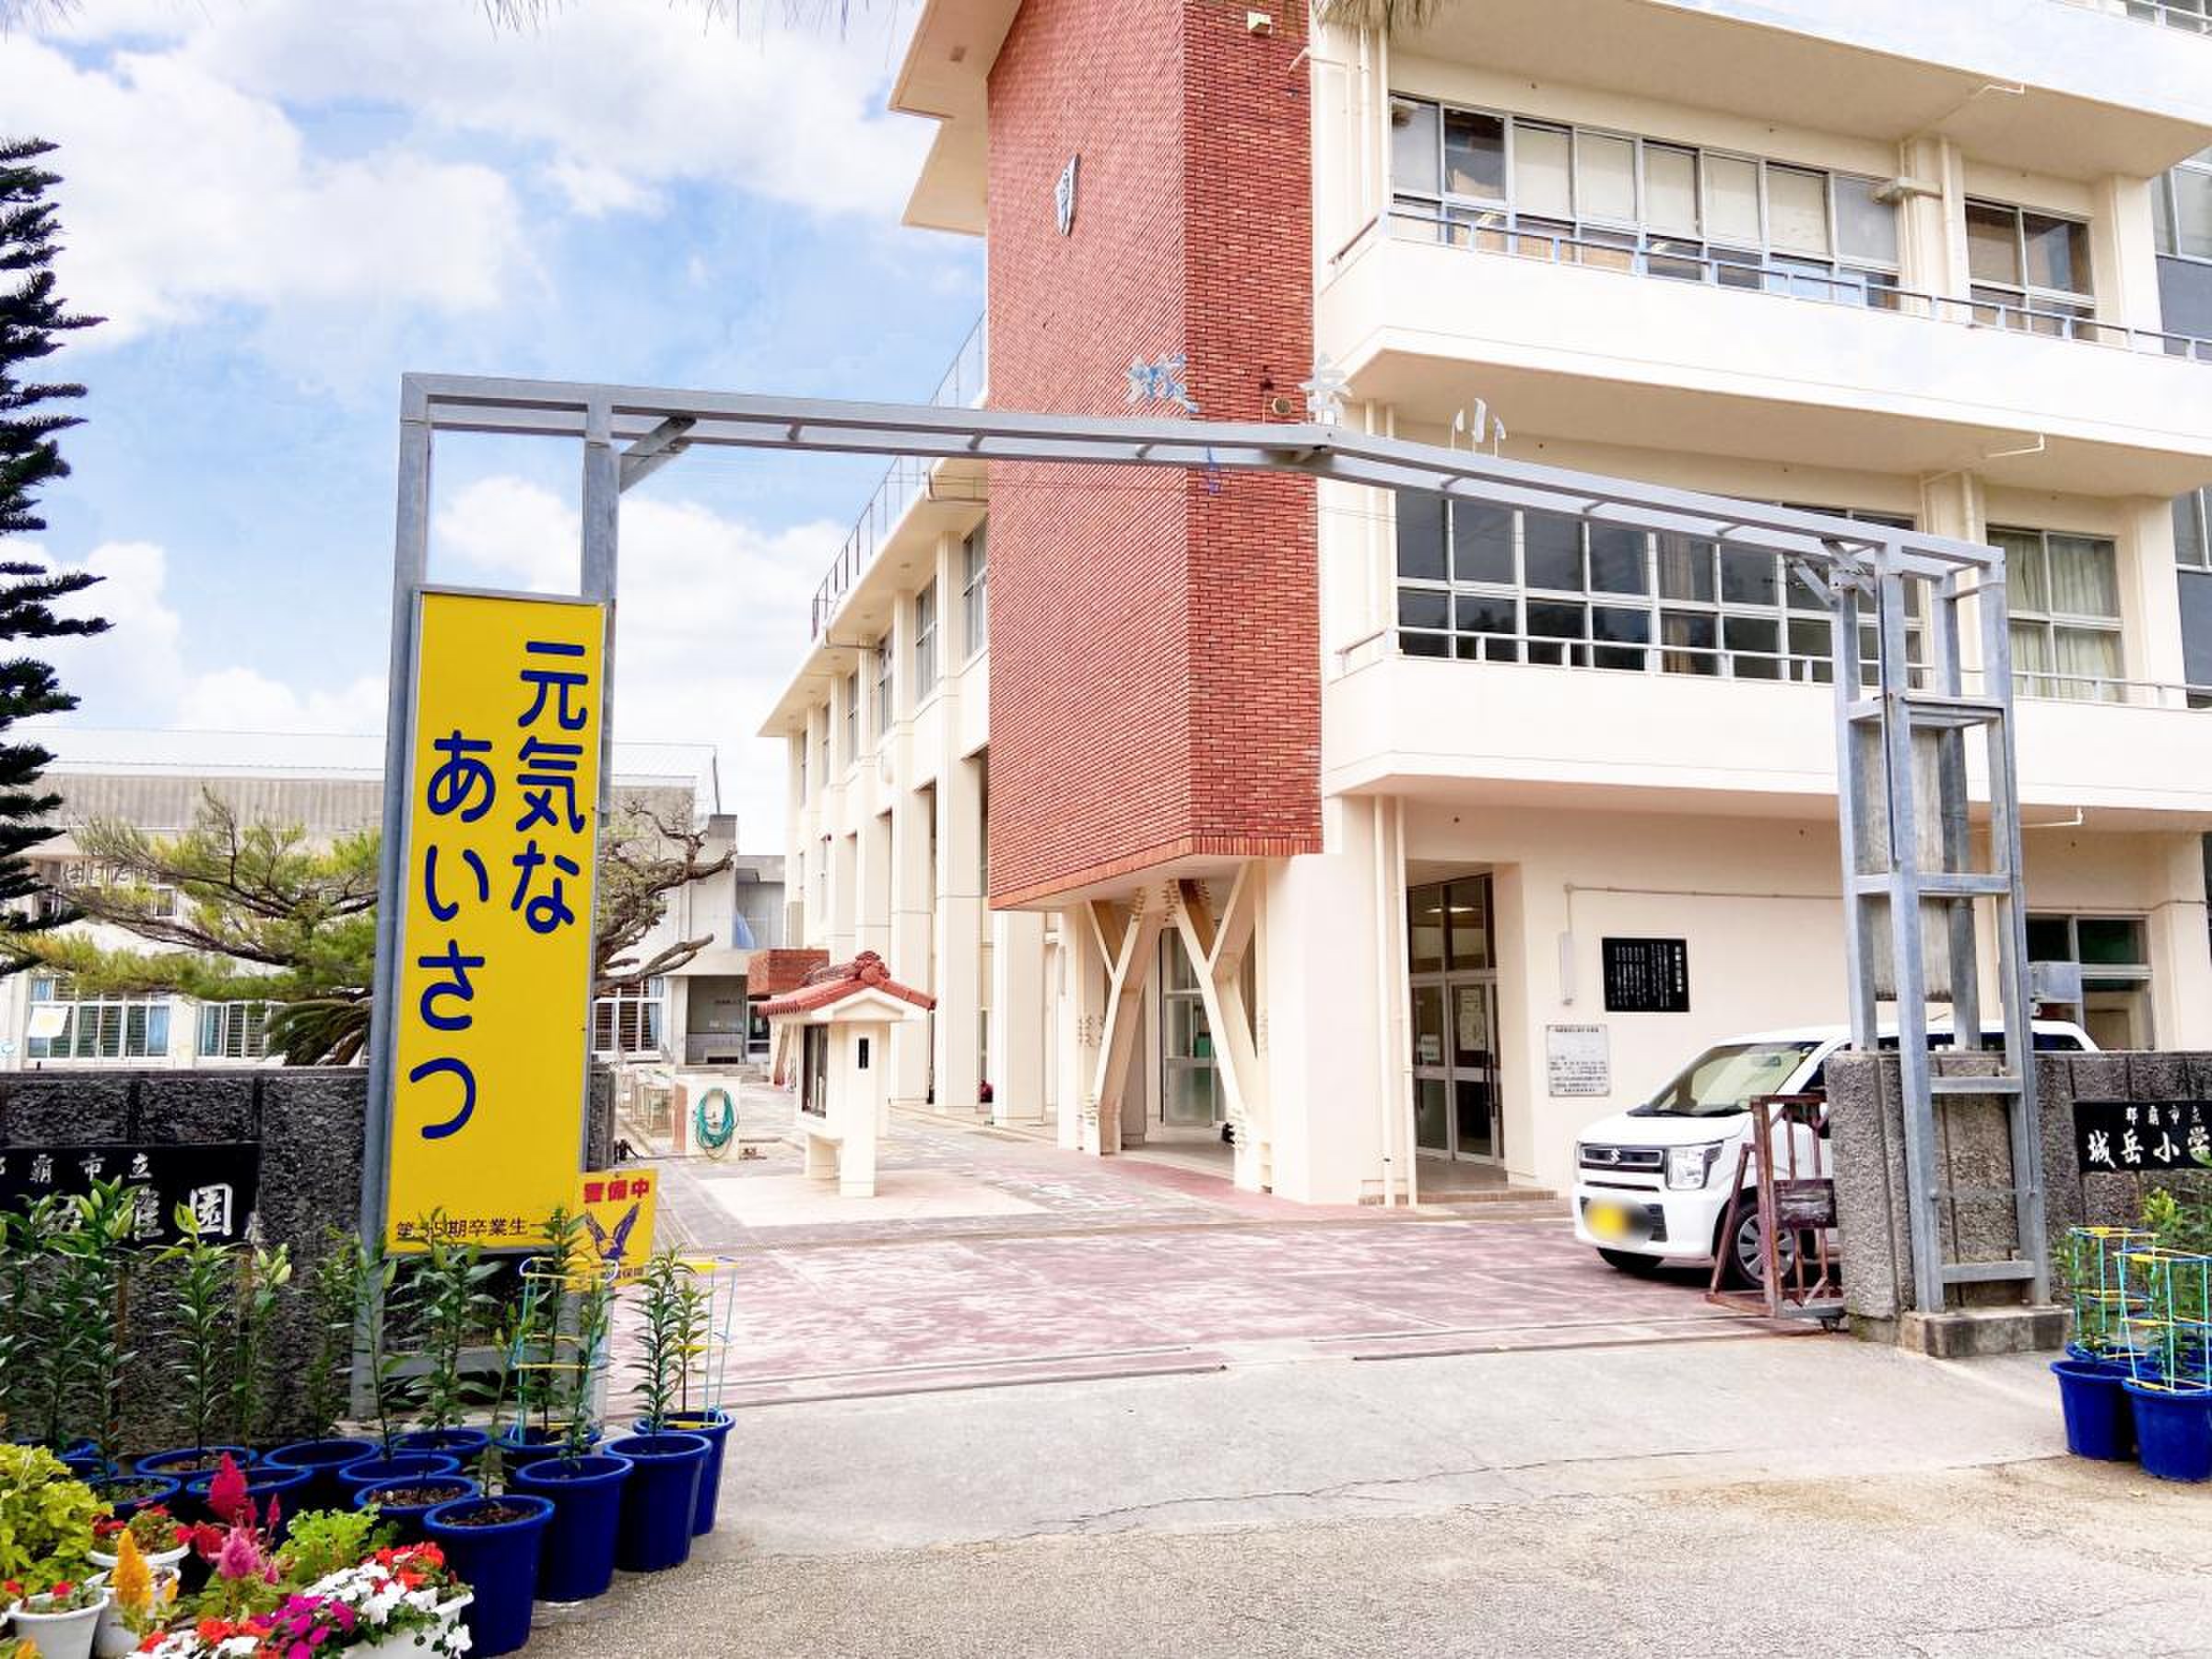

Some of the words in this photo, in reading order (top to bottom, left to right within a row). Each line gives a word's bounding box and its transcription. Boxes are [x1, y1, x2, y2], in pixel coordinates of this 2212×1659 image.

[512, 641, 587, 933] 元気な
[409, 730, 495, 1138] あいさつ
[0, 1153, 152, 1183] 覇市立
[583, 1179, 650, 1204] 警備中
